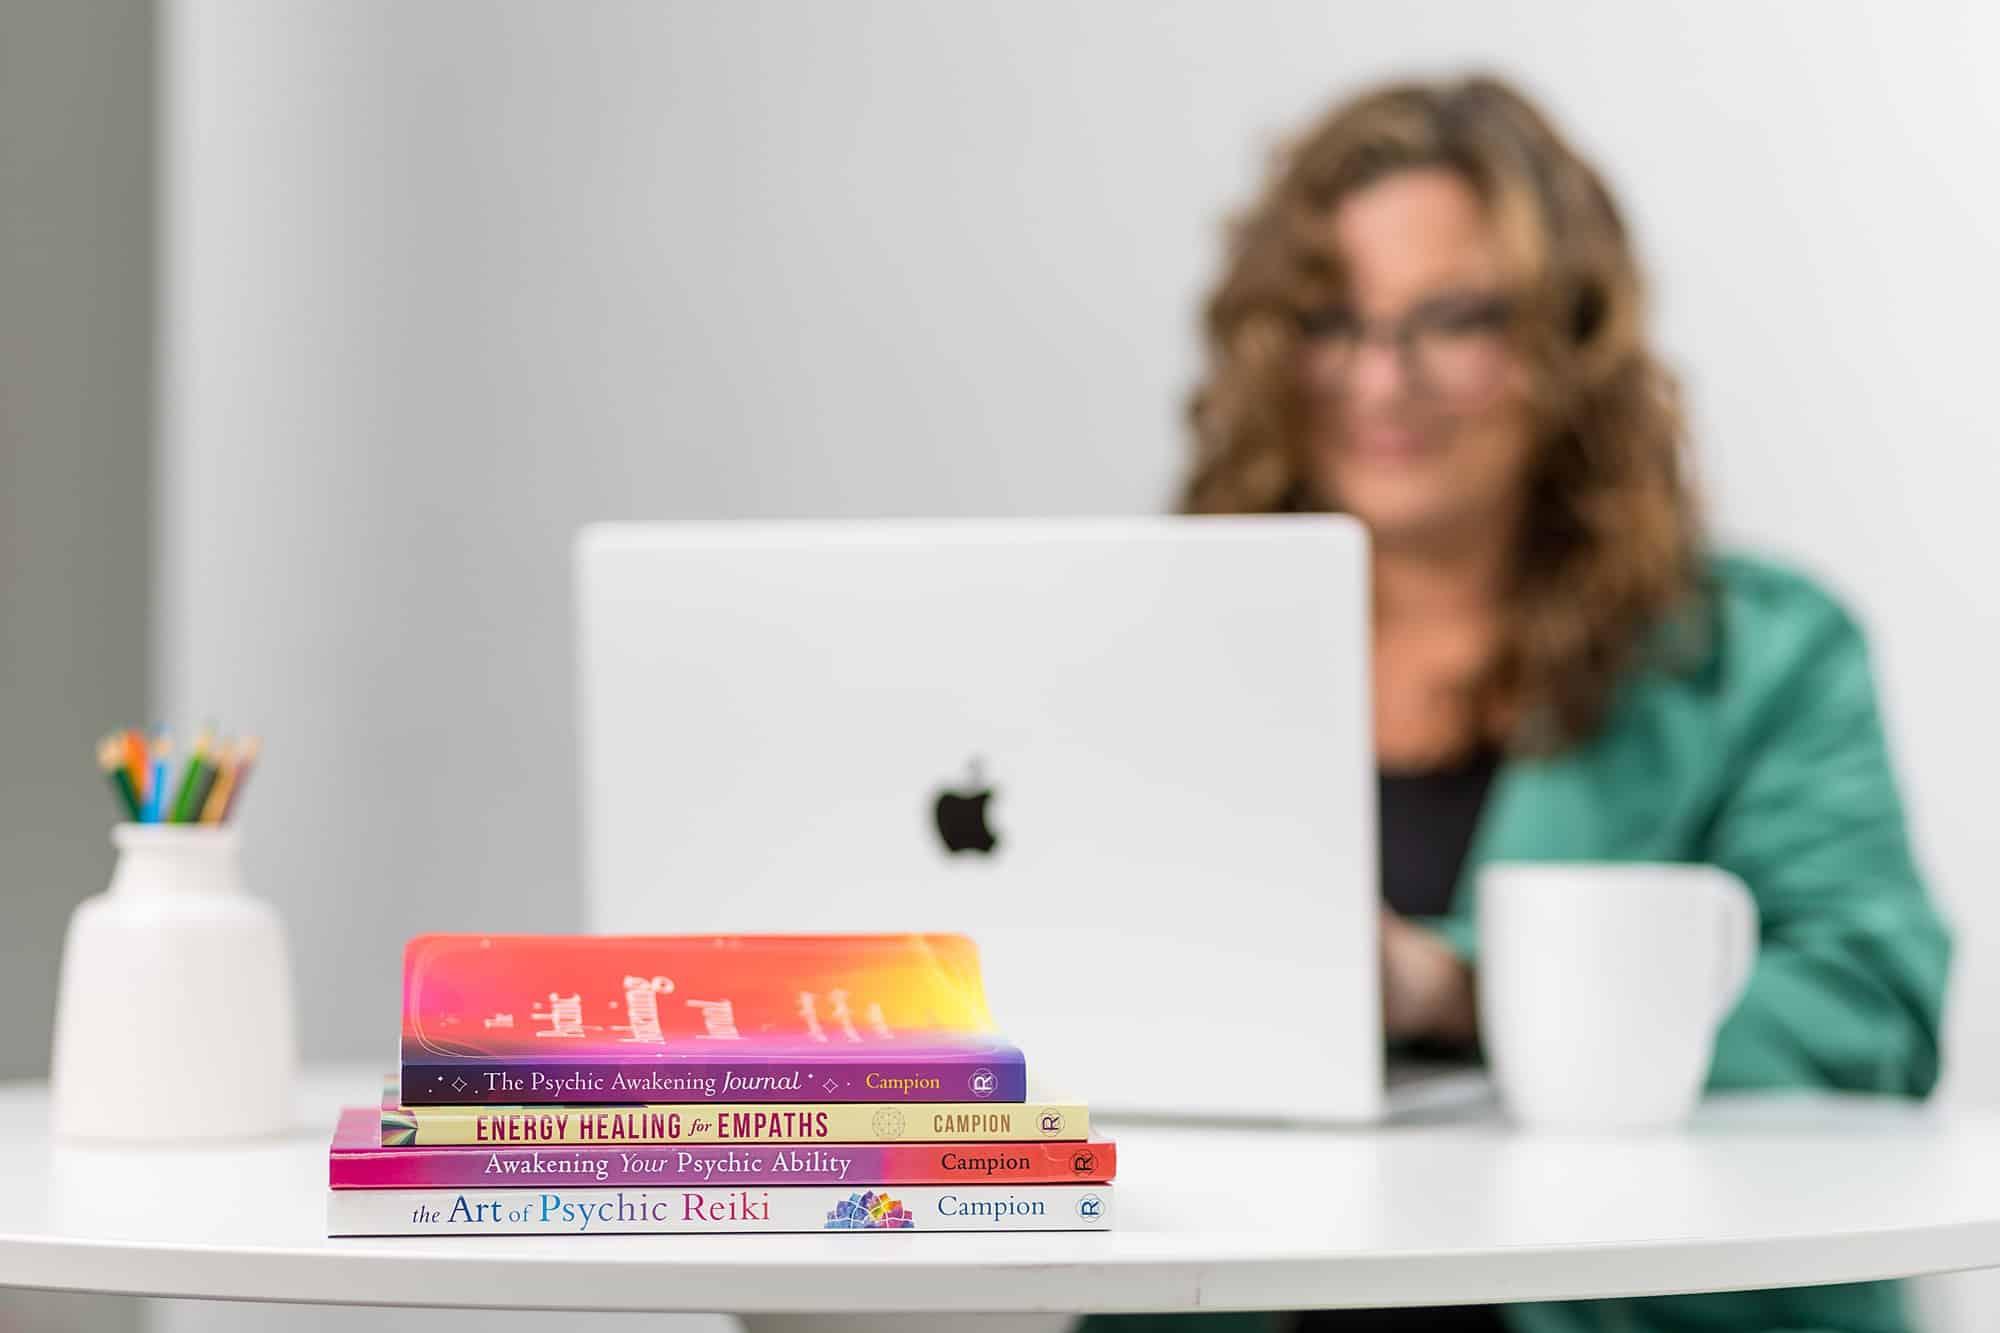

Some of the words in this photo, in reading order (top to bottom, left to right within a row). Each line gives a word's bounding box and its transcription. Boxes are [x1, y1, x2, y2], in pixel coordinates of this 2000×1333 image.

[483, 1071, 525, 1091] The
[531, 1071, 604, 1098] Psychic
[611, 1071, 717, 1097] Awakening
[721, 1071, 802, 1095] Journal
[865, 1072, 941, 1095] Campion
[476, 1115, 570, 1141] ENERGY
[579, 1113, 682, 1141] HEALING
[688, 1117, 713, 1137] for
[717, 1112, 829, 1139] EMPATHS
[933, 1113, 1012, 1134] CAMPION
[484, 1152, 609, 1181] Awakening
[619, 1153, 669, 1175] Your
[676, 1151, 763, 1179] Psychic
[772, 1151, 852, 1178] Ability
[940, 1153, 1031, 1176] Campion
[412, 1204, 441, 1224] the
[448, 1195, 503, 1224] Art
[508, 1203, 533, 1224] of
[538, 1193, 668, 1230] Psychic
[681, 1191, 770, 1222] Reiki
[936, 1194, 1046, 1221] Campion
